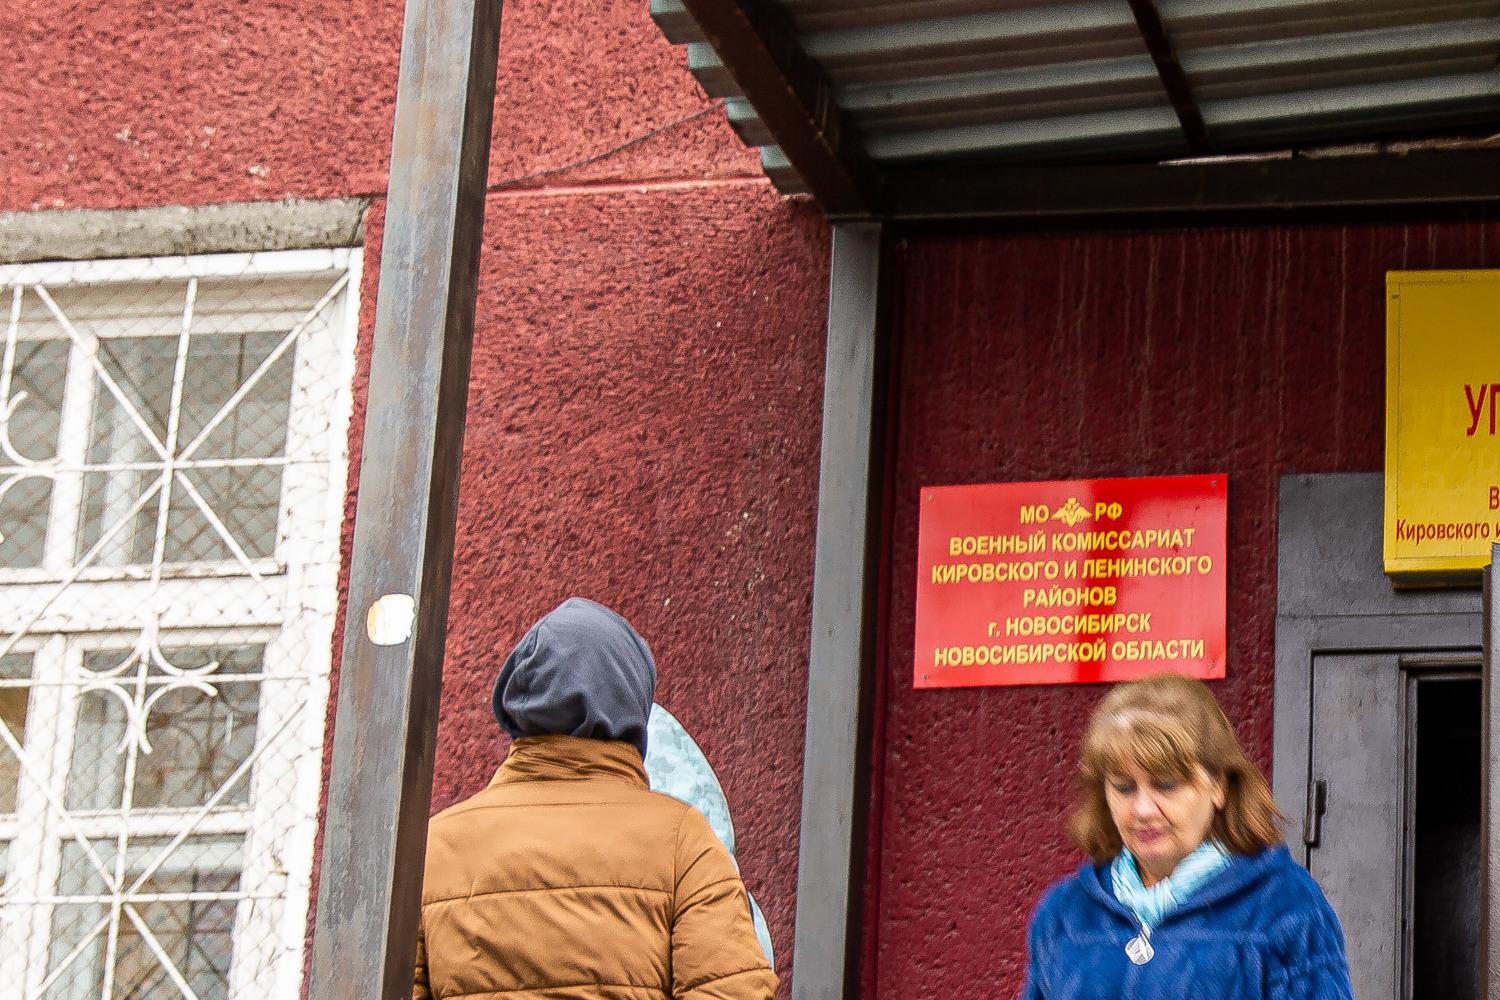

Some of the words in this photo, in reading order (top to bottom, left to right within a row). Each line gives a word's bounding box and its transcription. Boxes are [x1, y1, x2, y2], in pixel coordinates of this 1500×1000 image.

[1020, 505, 1049, 524] МО
[1095, 502, 1122, 522] РФ
[949, 529, 1047, 557] ВОЕННЫЙ
[1052, 528, 1195, 553] КОМИССАРИАТ
[1396, 518, 1490, 545] Кировского
[931, 560, 1059, 584] КИРОВСКОГО
[1064, 560, 1077, 578] И
[1082, 555, 1212, 578] ЛЕНИНСКОГО
[1023, 585, 1117, 608] РАЙОНОВ
[988, 621, 1000, 637] г.
[1006, 613, 1151, 636] НОВОСИБИРСК
[934, 638, 1107, 667] НОВОСИБИРСКОЙ
[1112, 640, 1204, 660] ОБЛАСТИ
